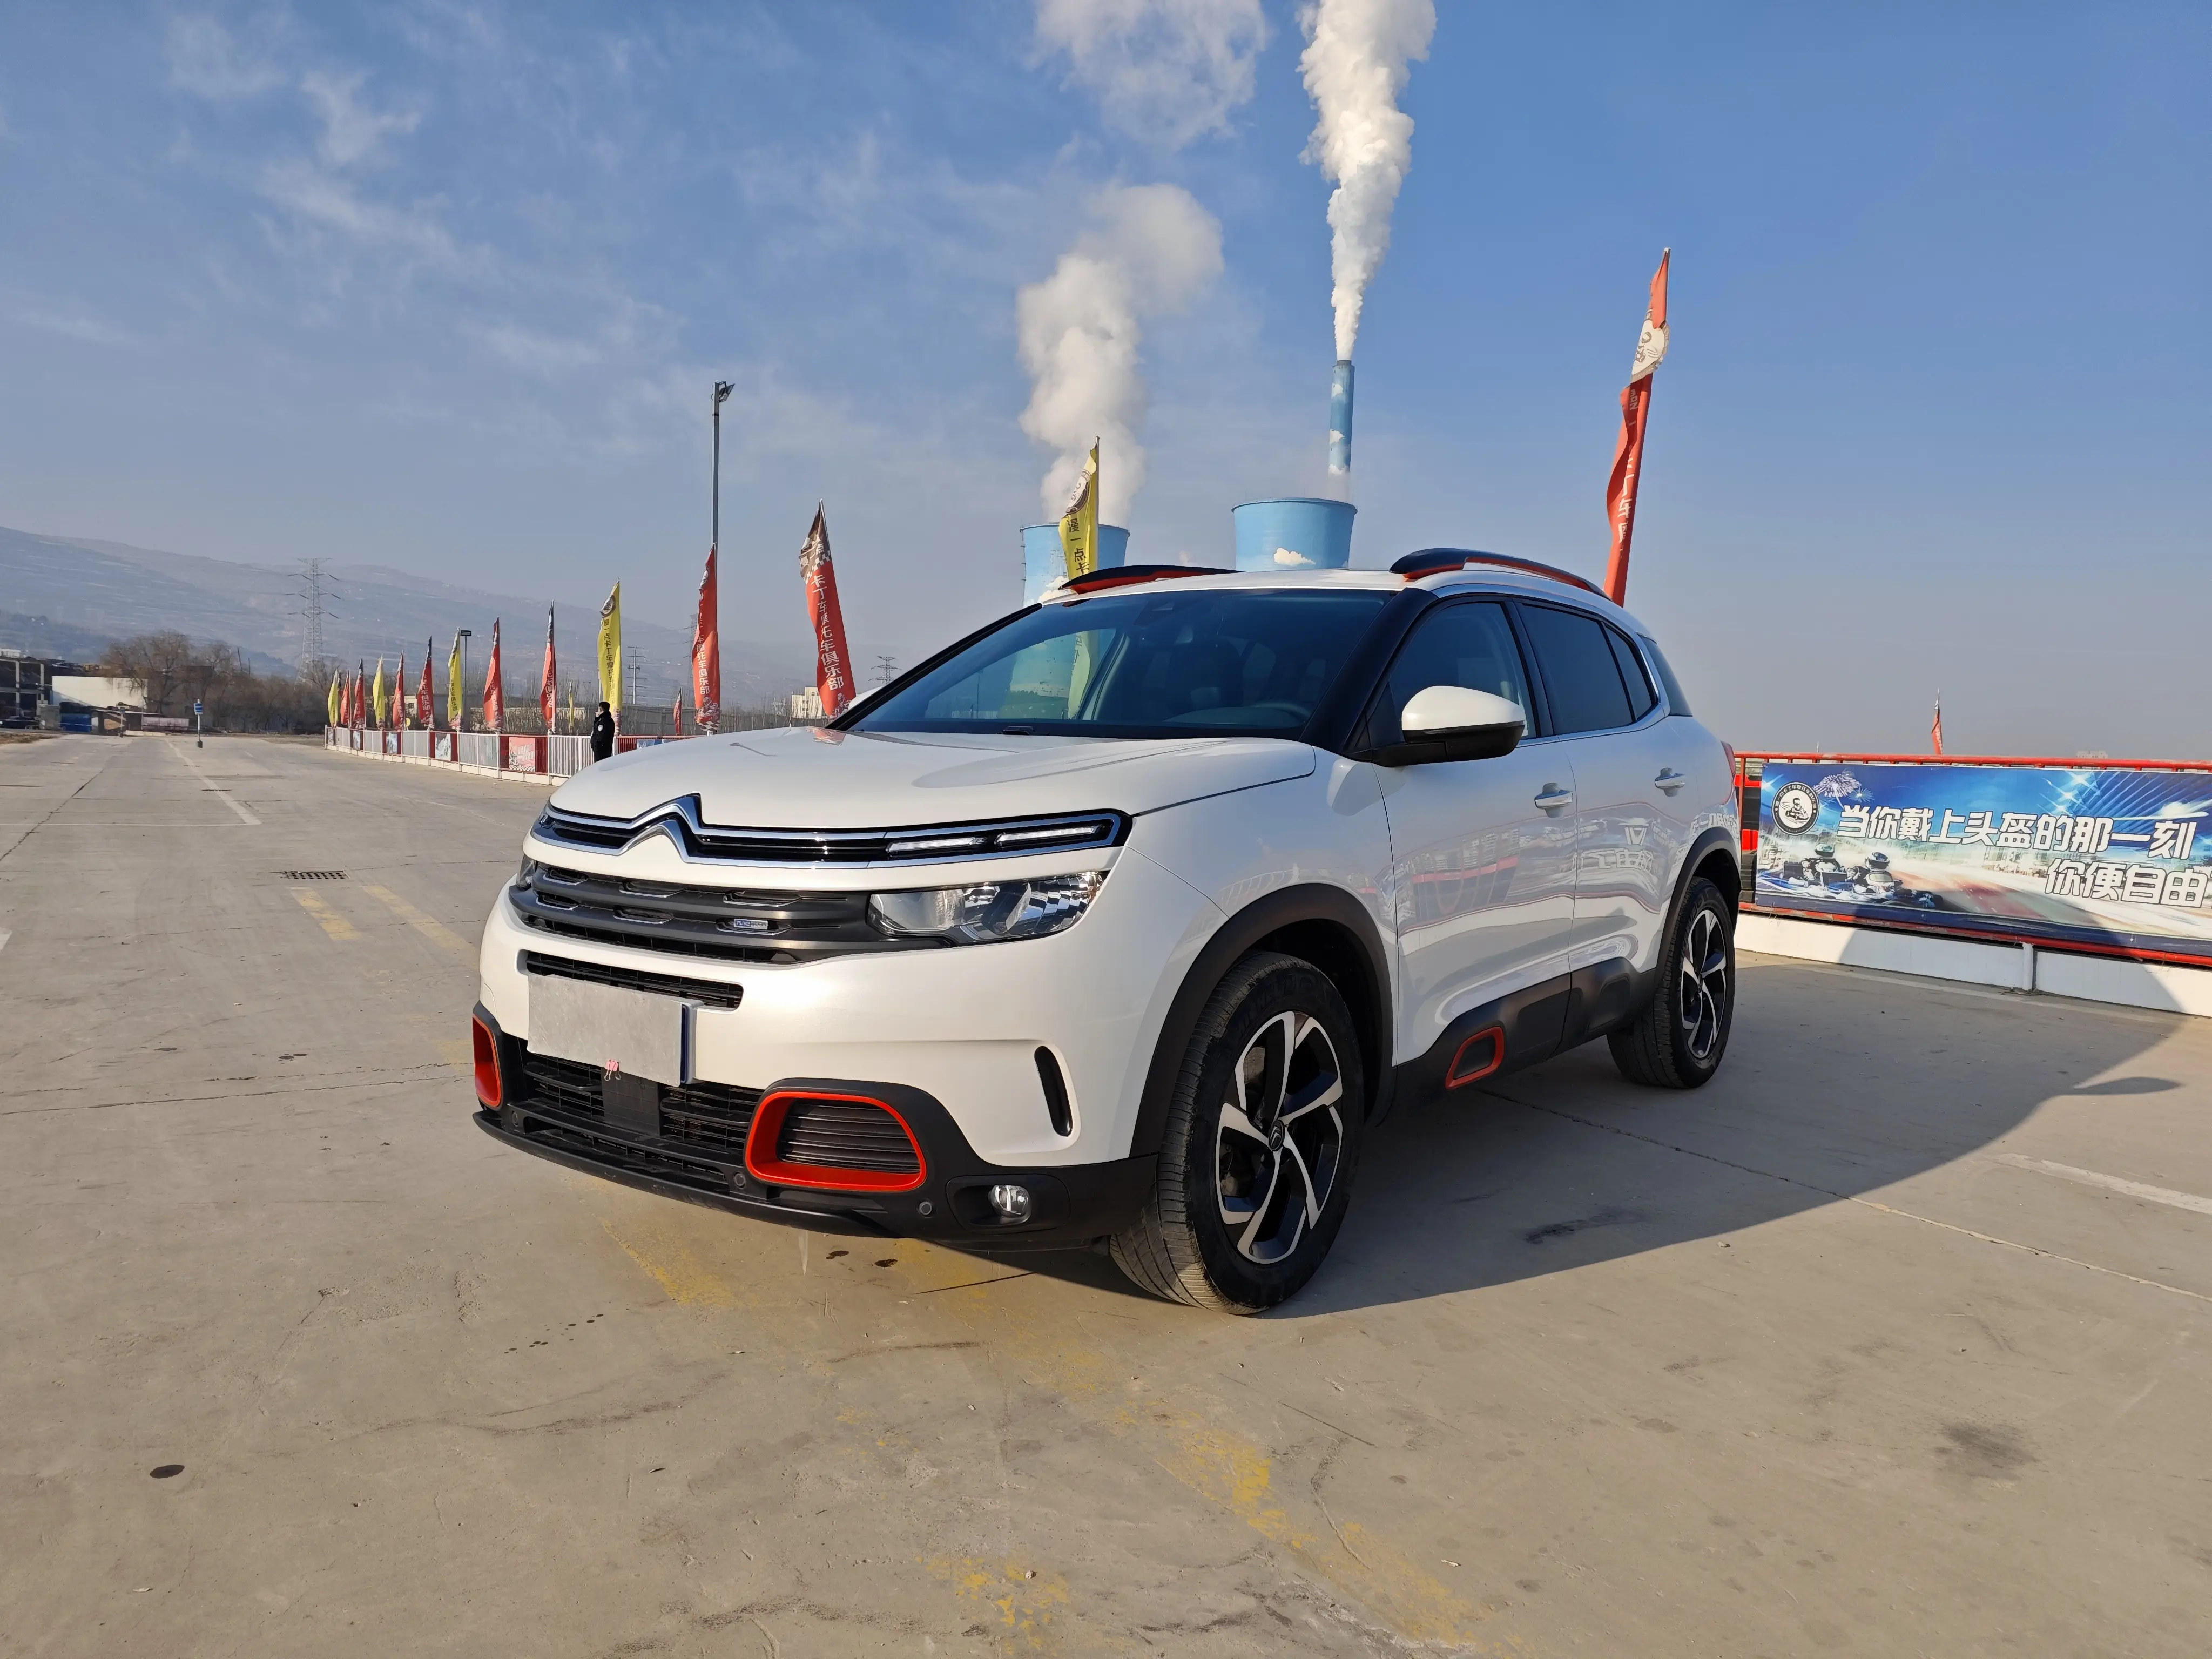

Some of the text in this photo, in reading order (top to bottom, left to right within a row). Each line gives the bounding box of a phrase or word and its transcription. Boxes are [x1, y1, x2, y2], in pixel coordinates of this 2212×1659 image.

[1836, 804, 2198, 860] 当你戴上头盔的那一刻
[2045, 858, 2212, 908] 你便自由
